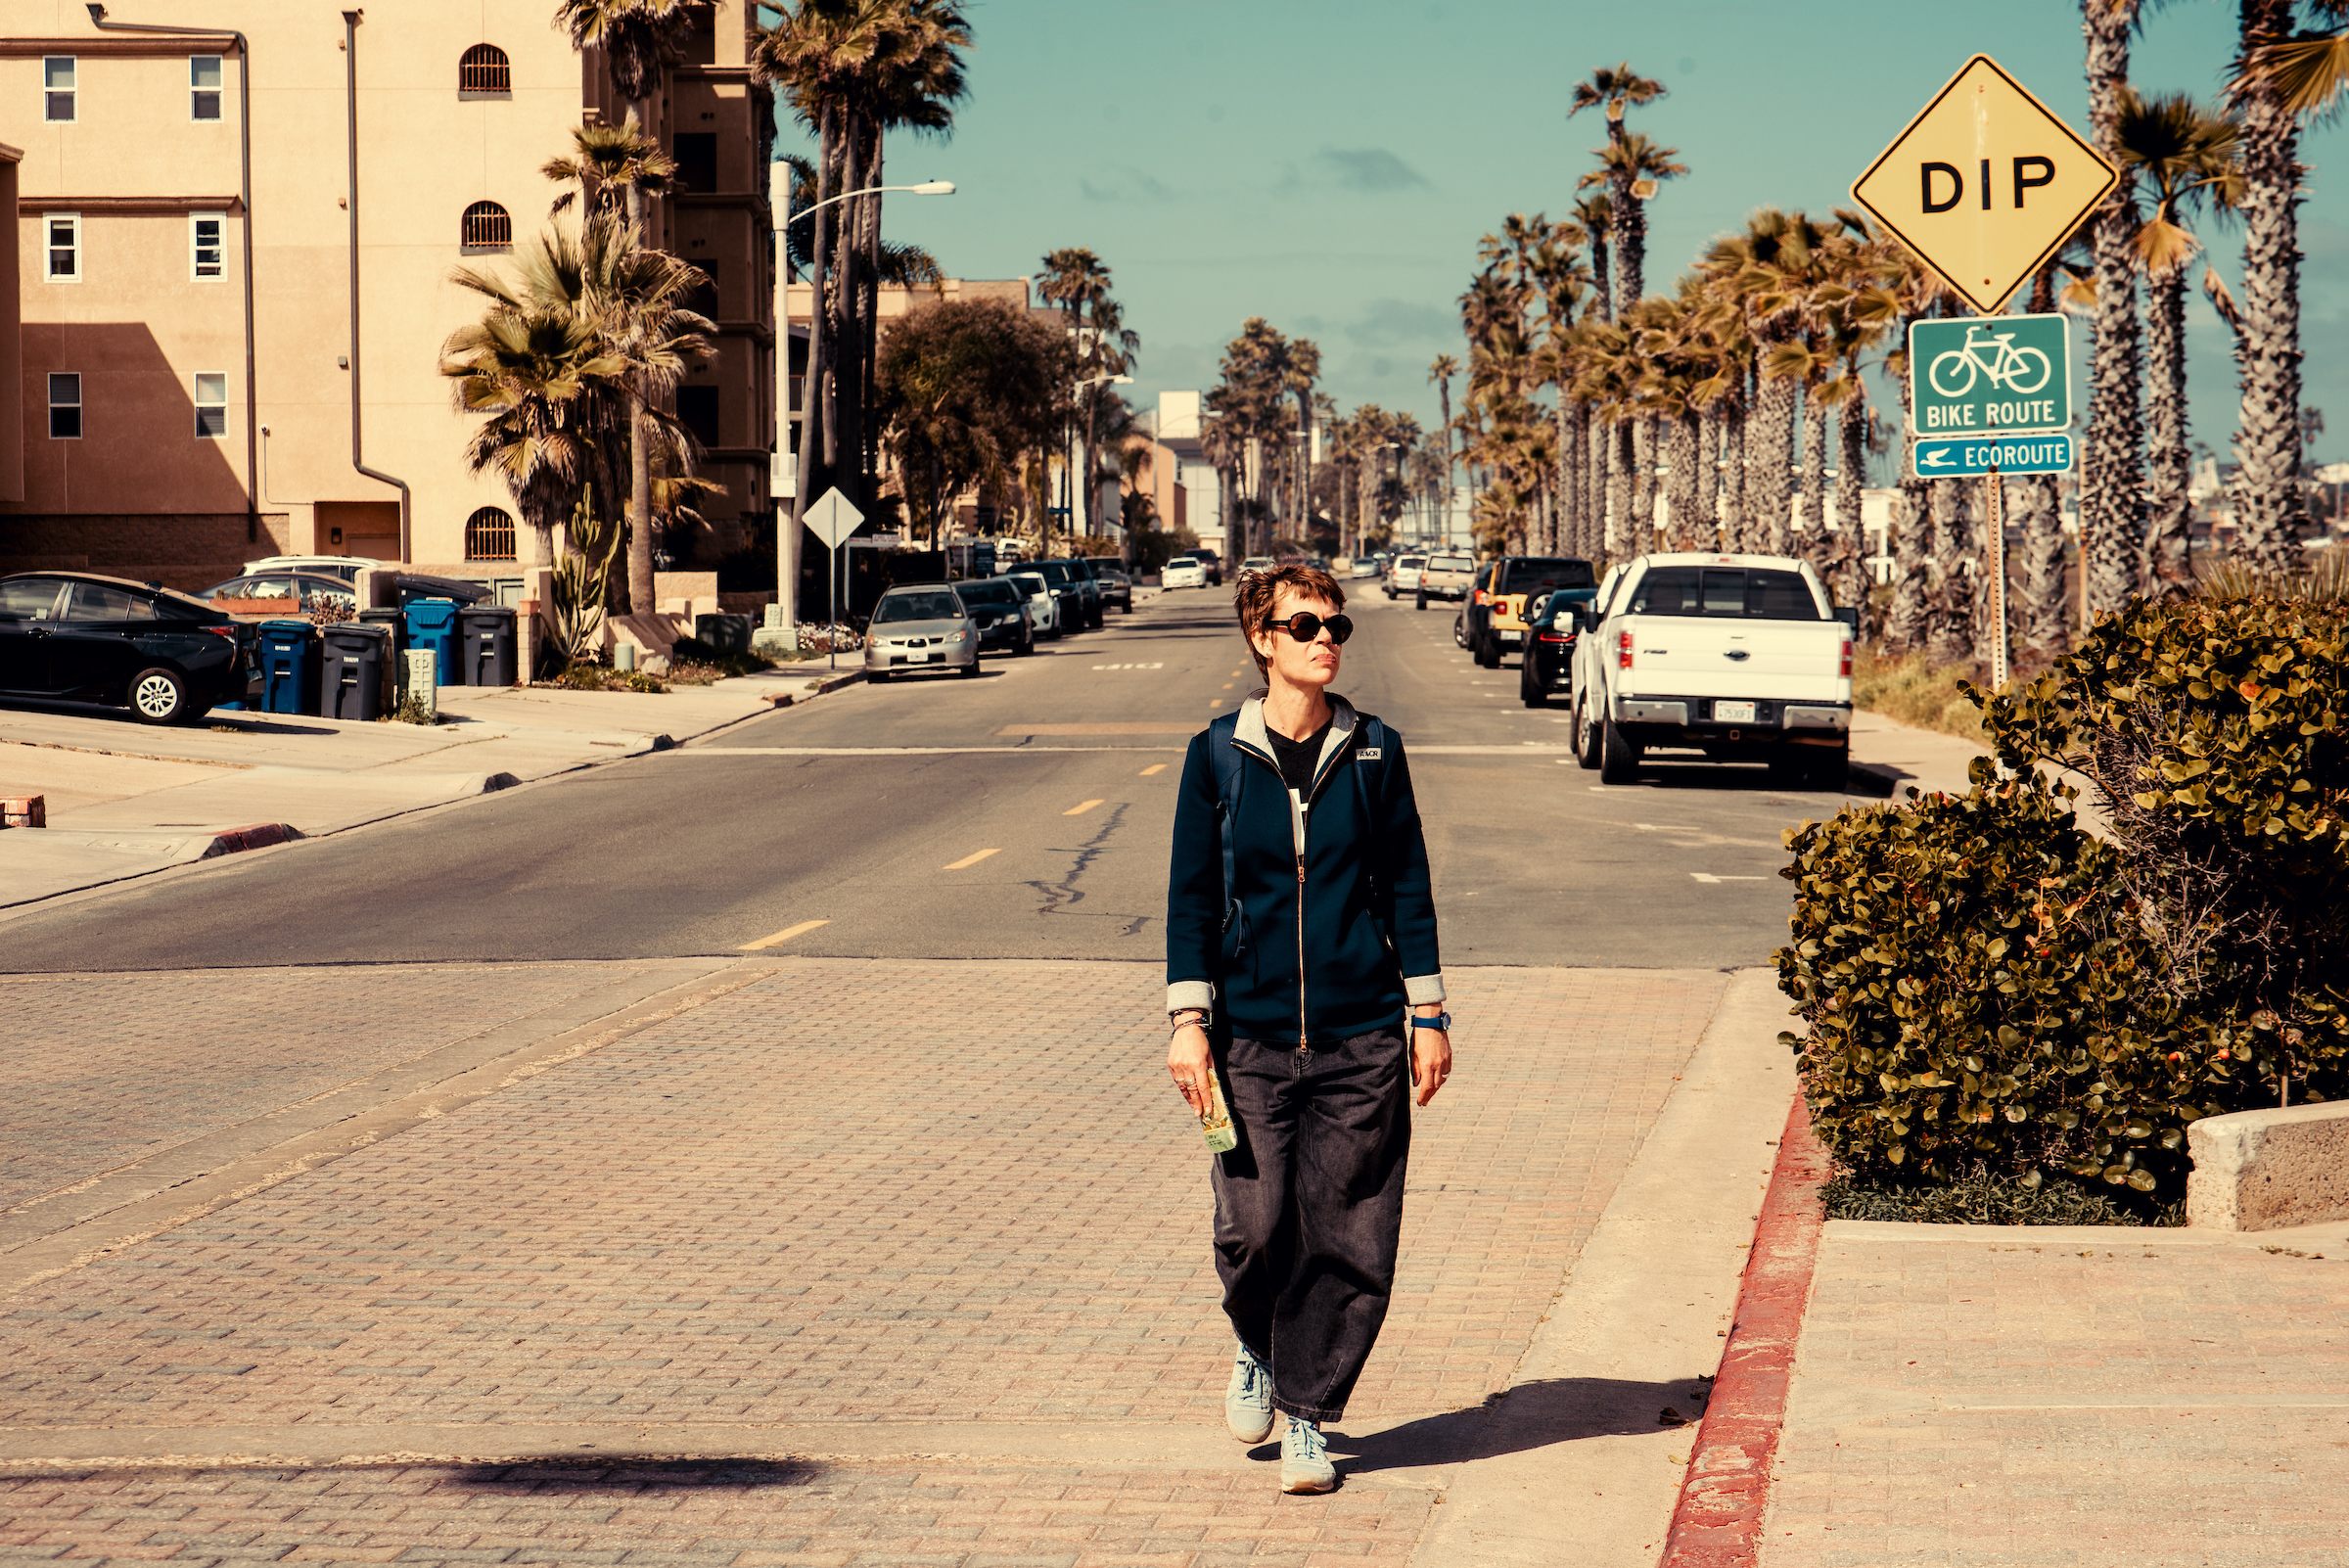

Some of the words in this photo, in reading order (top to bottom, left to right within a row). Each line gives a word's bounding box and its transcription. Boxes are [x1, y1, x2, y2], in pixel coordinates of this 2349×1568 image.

[1920, 156, 2055, 213] DIP
[1926, 403, 1976, 428] BIKE
[1985, 399, 2056, 425] ROUTE
[1964, 443, 2067, 468] ECOROUTE
